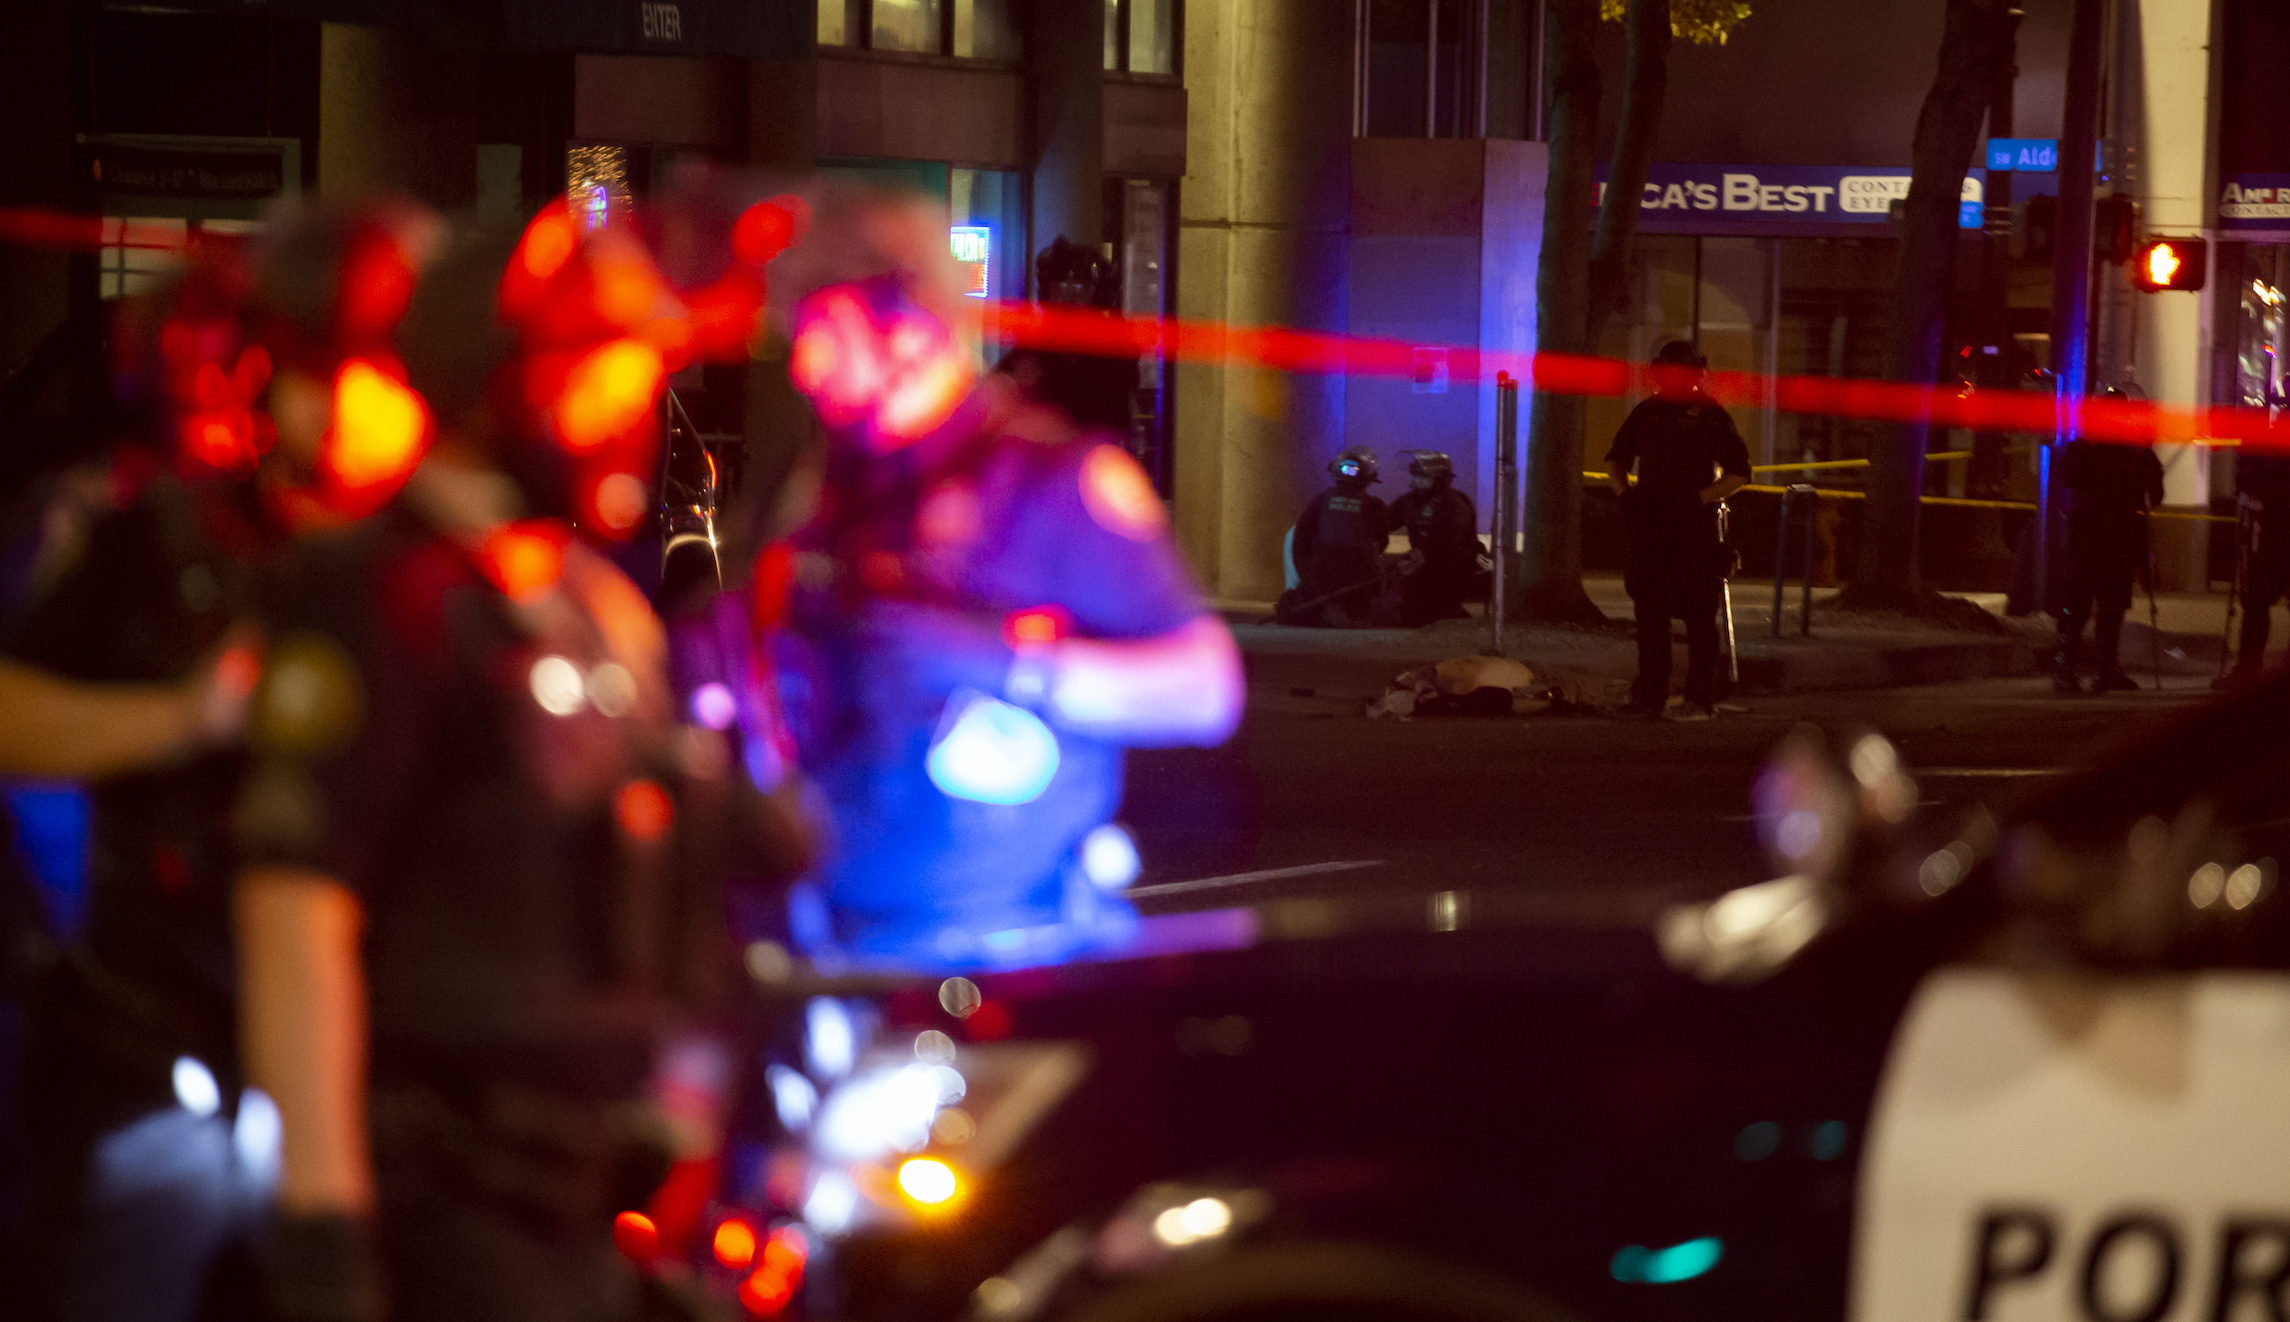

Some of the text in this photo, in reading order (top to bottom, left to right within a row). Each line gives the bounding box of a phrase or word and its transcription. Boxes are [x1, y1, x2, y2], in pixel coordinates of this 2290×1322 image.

[641, 2, 681, 40] ENTER
[1722, 173, 1834, 212] BEST
[1848, 197, 1889, 209] EYE
[1966, 1204, 2290, 1322] POR
